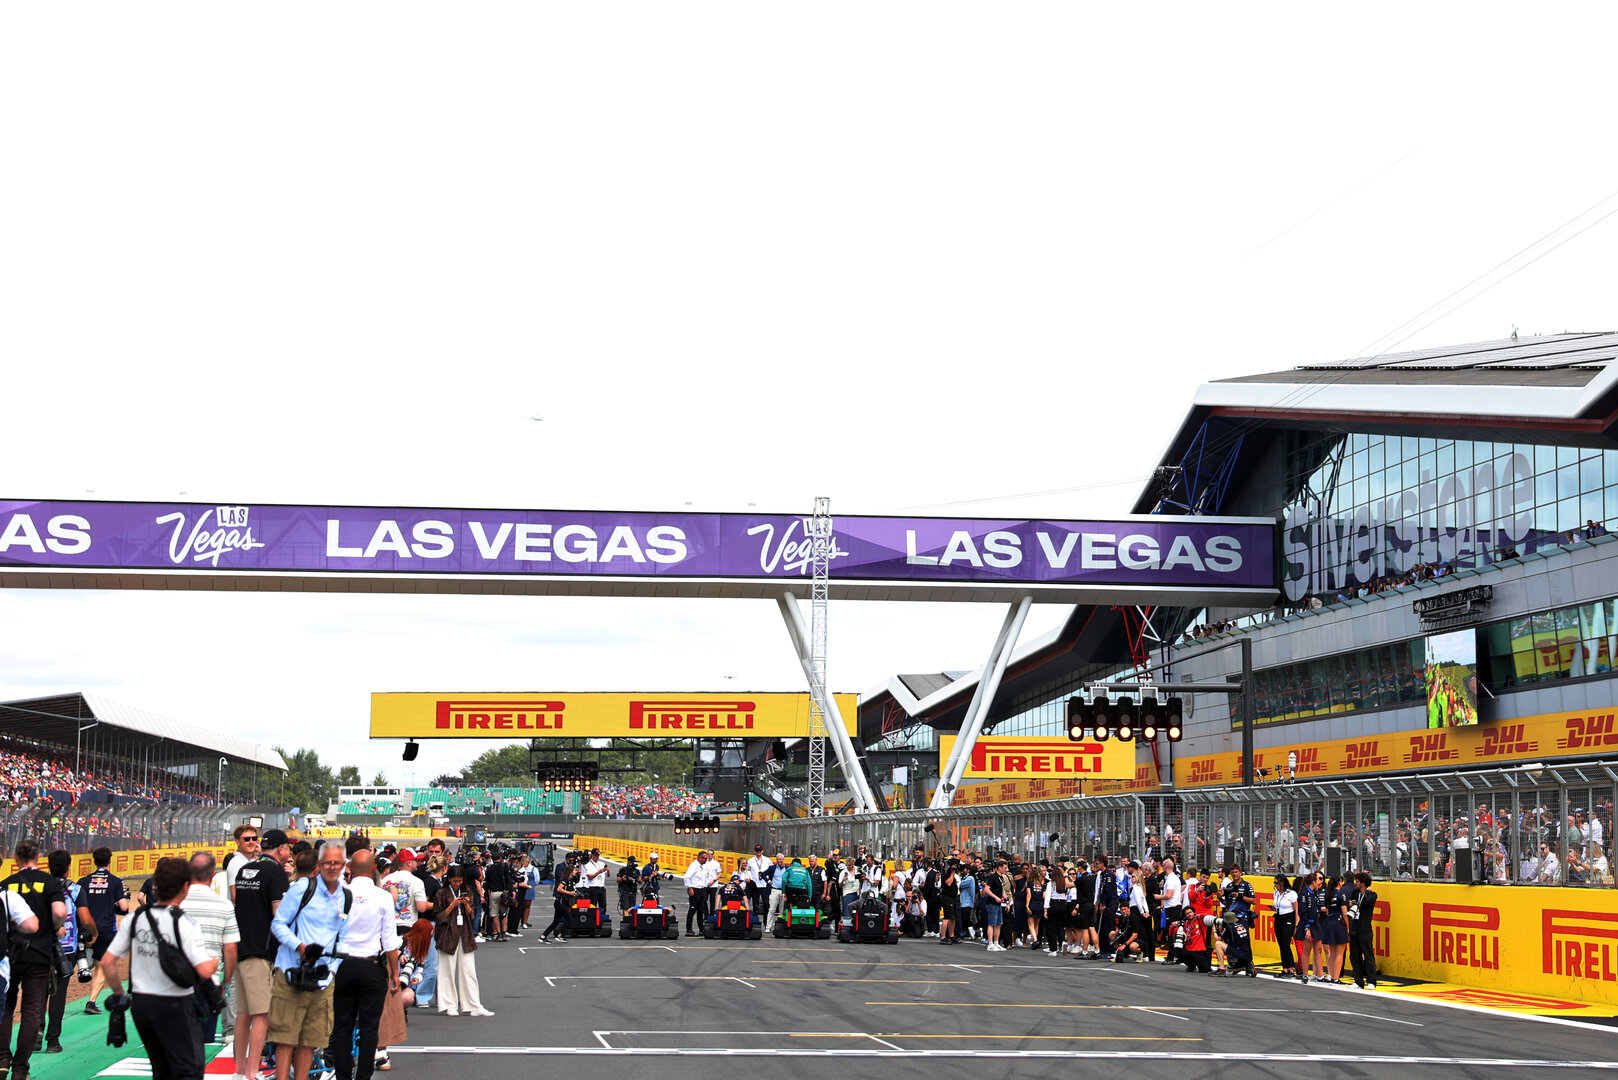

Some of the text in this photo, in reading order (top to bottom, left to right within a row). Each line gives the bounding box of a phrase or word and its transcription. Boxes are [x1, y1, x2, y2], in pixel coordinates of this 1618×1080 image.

[220, 508, 247, 524] LAS
[1283, 453, 1533, 601] Silverstone
[156, 509, 265, 567] Vegas
[326, 519, 688, 564] LAS VEGAS
[906, 530, 1243, 572] LAS VEGAS
[436, 701, 566, 729] PIRELLI
[629, 701, 756, 729] PIRELLI
[1566, 714, 1618, 748] DHL
[1346, 741, 1381, 768] DHL
[1410, 733, 1450, 762] DHL
[1482, 724, 1529, 756] DHL
[971, 742, 1104, 773] PIRELLI
[1191, 760, 1217, 782] DHL
[1423, 902, 1500, 970] PIRELLI
[1542, 908, 1618, 982] PIREL
